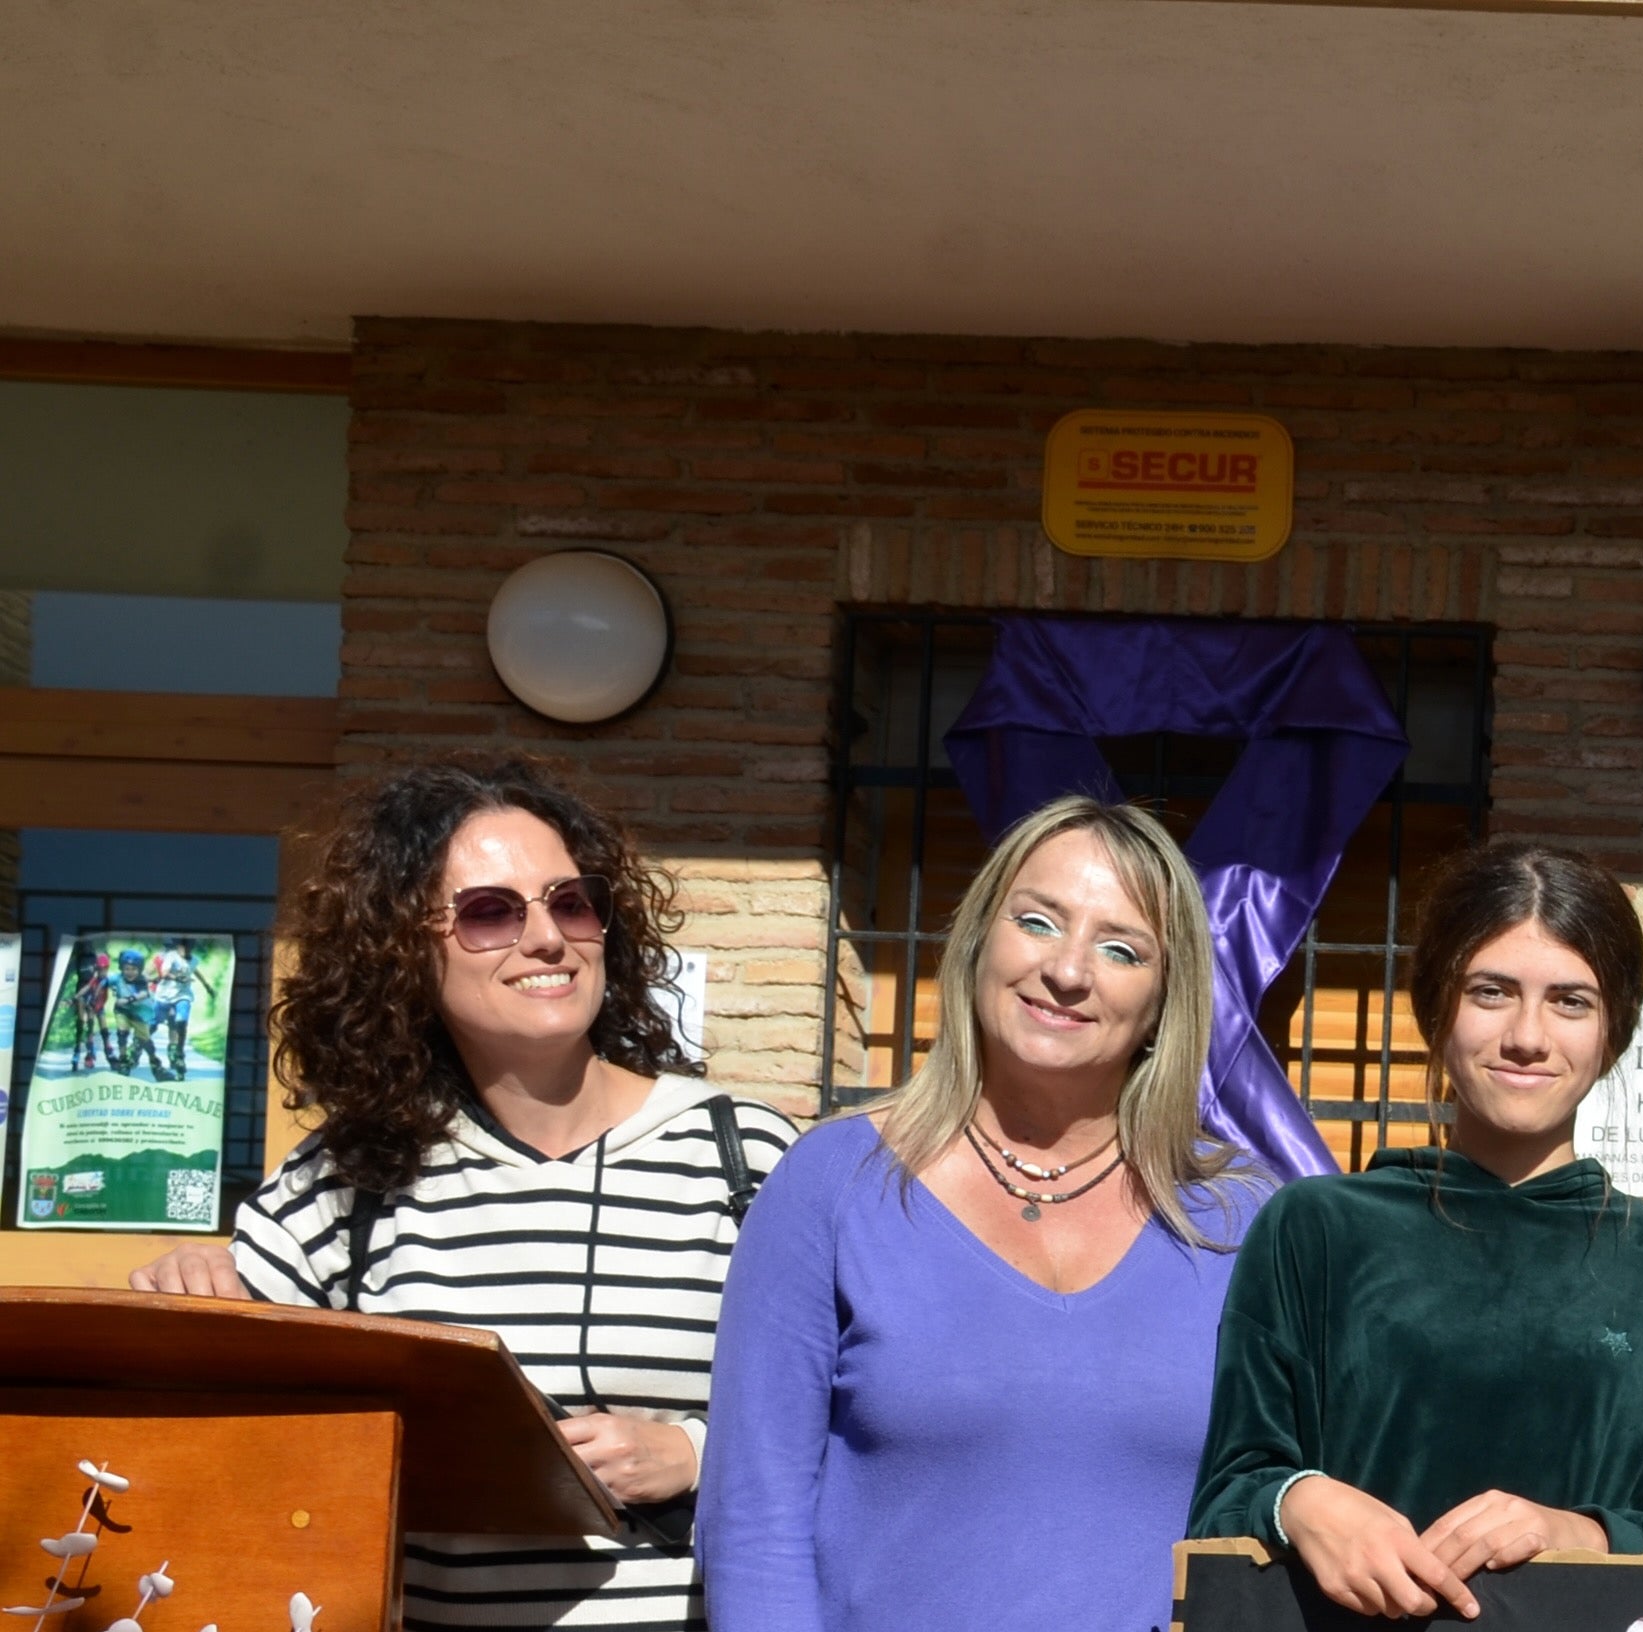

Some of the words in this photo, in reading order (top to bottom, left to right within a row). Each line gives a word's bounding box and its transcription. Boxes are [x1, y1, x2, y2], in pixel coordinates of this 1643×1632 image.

[1111, 450, 1258, 484] SECUR
[37, 1087, 94, 1116] CURSO
[98, 1084, 122, 1101] DE
[128, 1085, 224, 1119] PATINAJE
[1592, 1126, 1619, 1142] DE
